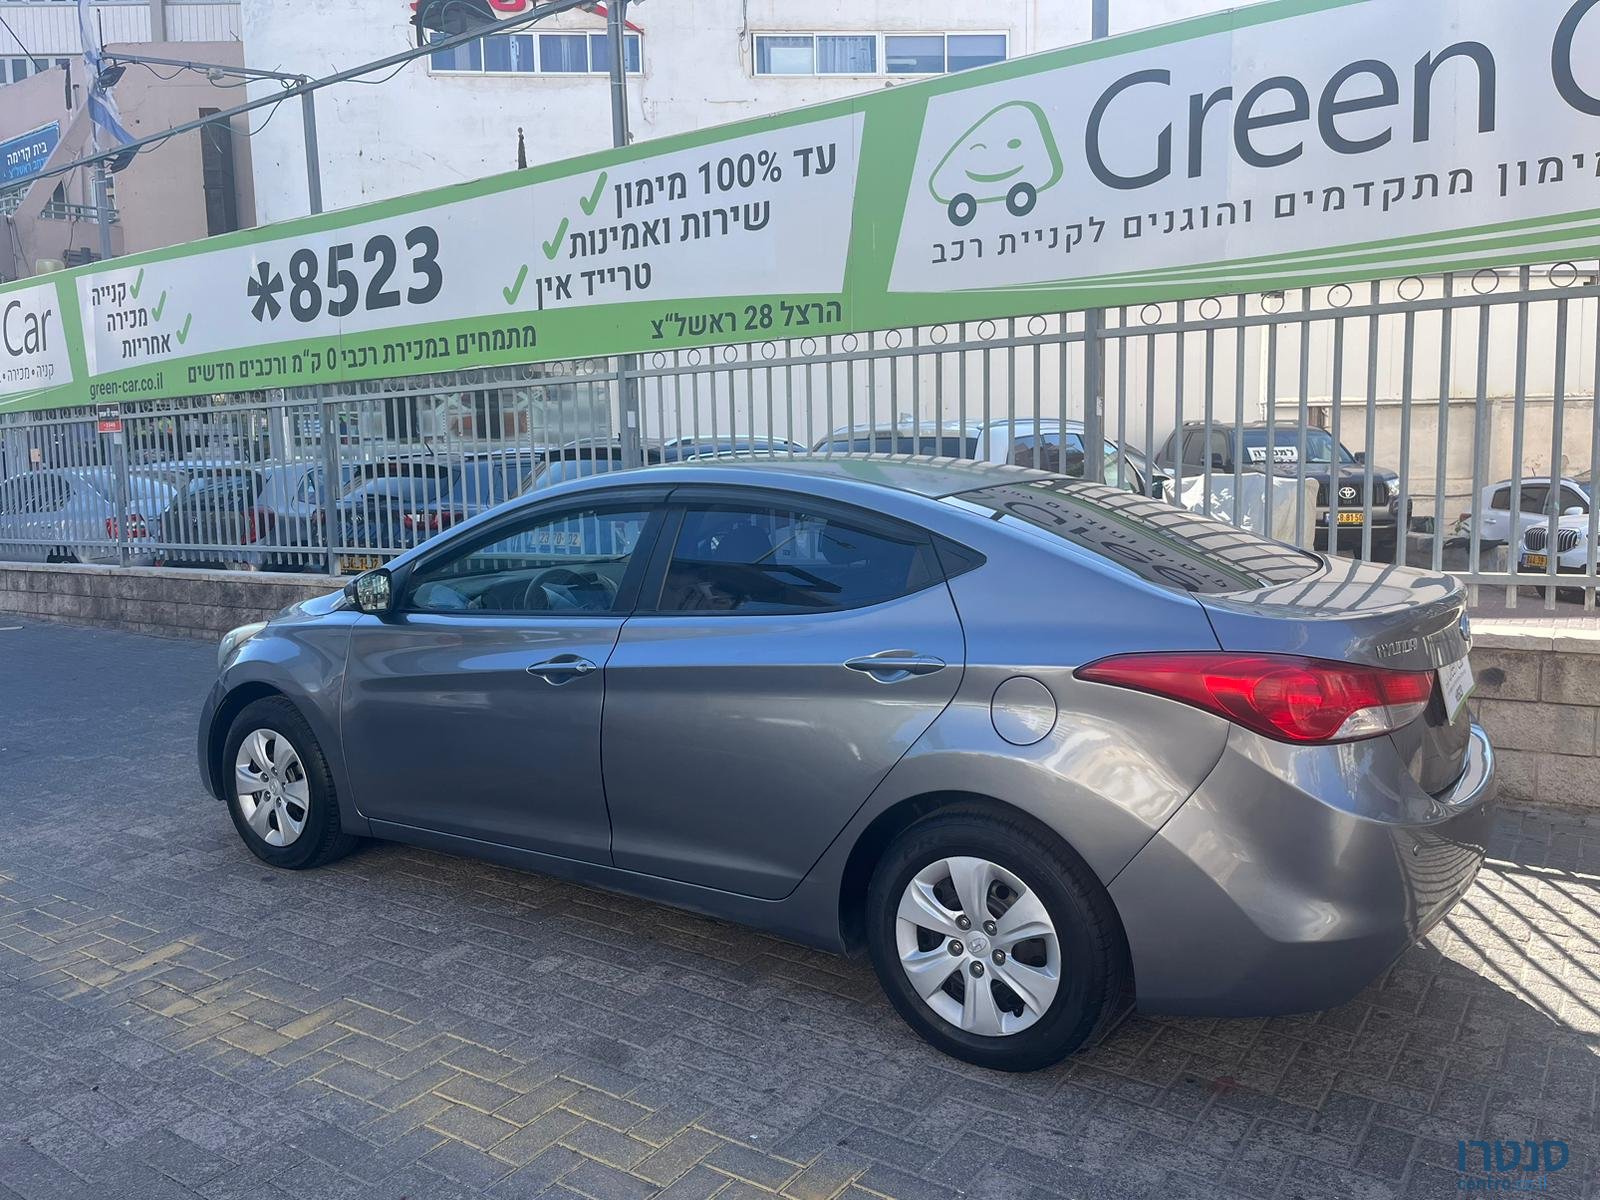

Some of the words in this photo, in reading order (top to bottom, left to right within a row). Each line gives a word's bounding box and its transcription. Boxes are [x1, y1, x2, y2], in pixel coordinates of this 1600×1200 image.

[1085, 40, 1497, 191] Green
[33, 142, 48, 157] בית
[793, 143, 837, 178] עד
[698, 150, 783, 195] 100%
[1497, 150, 1600, 198] ימון
[614, 172, 688, 219] מימון
[1274, 168, 1474, 218] מתקדמים
[680, 200, 771, 242] שירות
[1123, 199, 1253, 239] והוגנים
[568, 217, 671, 259] ואמינות
[997, 216, 1106, 256] לקניית
[932, 238, 984, 264] רכב
[535, 273, 573, 311] אין
[580, 262, 652, 296] טרייד
[91, 282, 127, 307] קנייה
[3, 300, 52, 357] Car
[106, 307, 148, 332] מכירה
[744, 303, 773, 331] 28
[780, 301, 842, 327] הרצל
[121, 333, 172, 359] אחריות
[382, 336, 451, 365] במכירת
[455, 325, 537, 356] מתמחים
[36, 363, 54, 380] קניה
[239, 356, 287, 378] ורכבים
[326, 347, 337, 371] 0
[341, 346, 378, 369] רכבי
[7, 367, 30, 382] מכירה
[89, 371, 164, 400] green-car.co.il
[187, 362, 235, 384] חדשים
